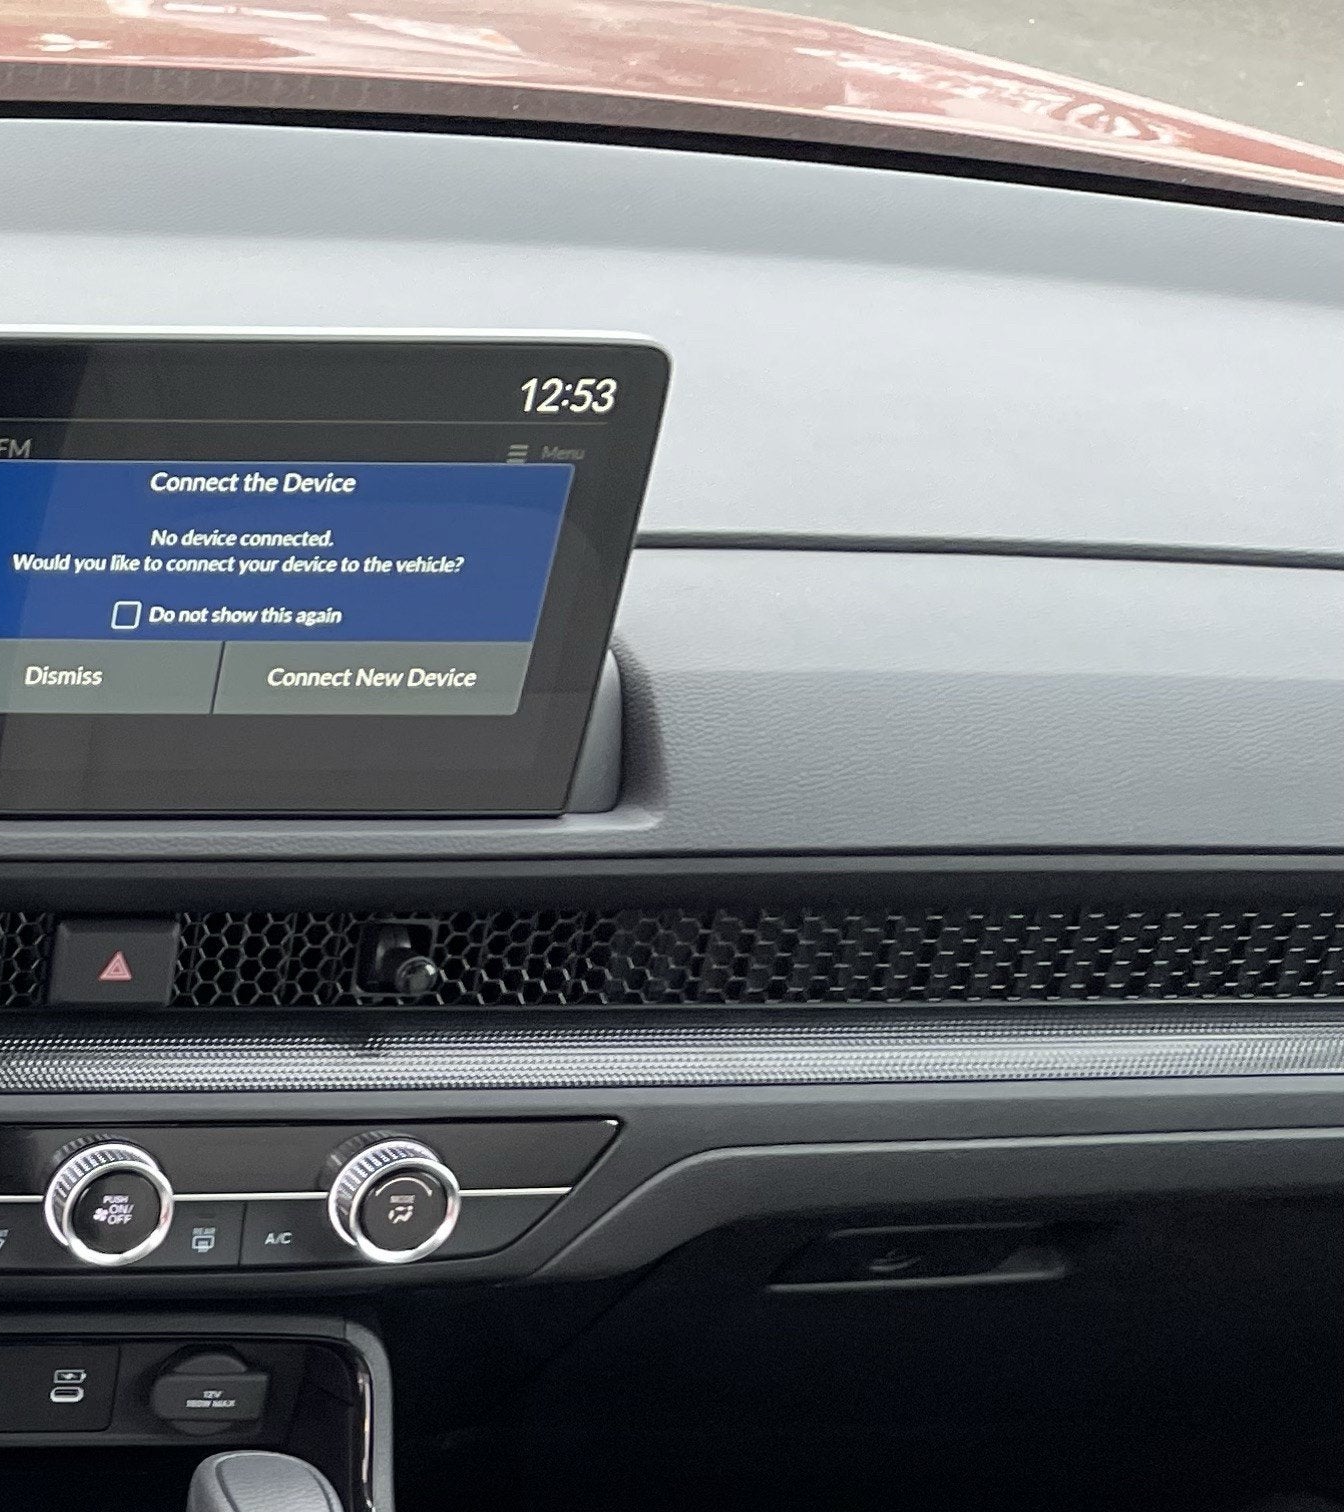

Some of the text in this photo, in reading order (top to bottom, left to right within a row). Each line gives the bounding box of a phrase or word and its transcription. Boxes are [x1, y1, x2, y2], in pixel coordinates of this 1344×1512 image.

[521, 377, 618, 414] 12:53
[541, 445, 585, 460] Menu
[150, 472, 357, 493] Connect the Device
[151, 529, 334, 547] No device connected.
[13, 553, 465, 575] Would you like to connect your device to the vehicle?
[149, 606, 343, 627] Do not show this again
[24, 665, 104, 686] Dismiss
[267, 667, 478, 688] Connect New Device
[107, 1214, 133, 1225] OFF
[264, 1231, 293, 1245] A/C
